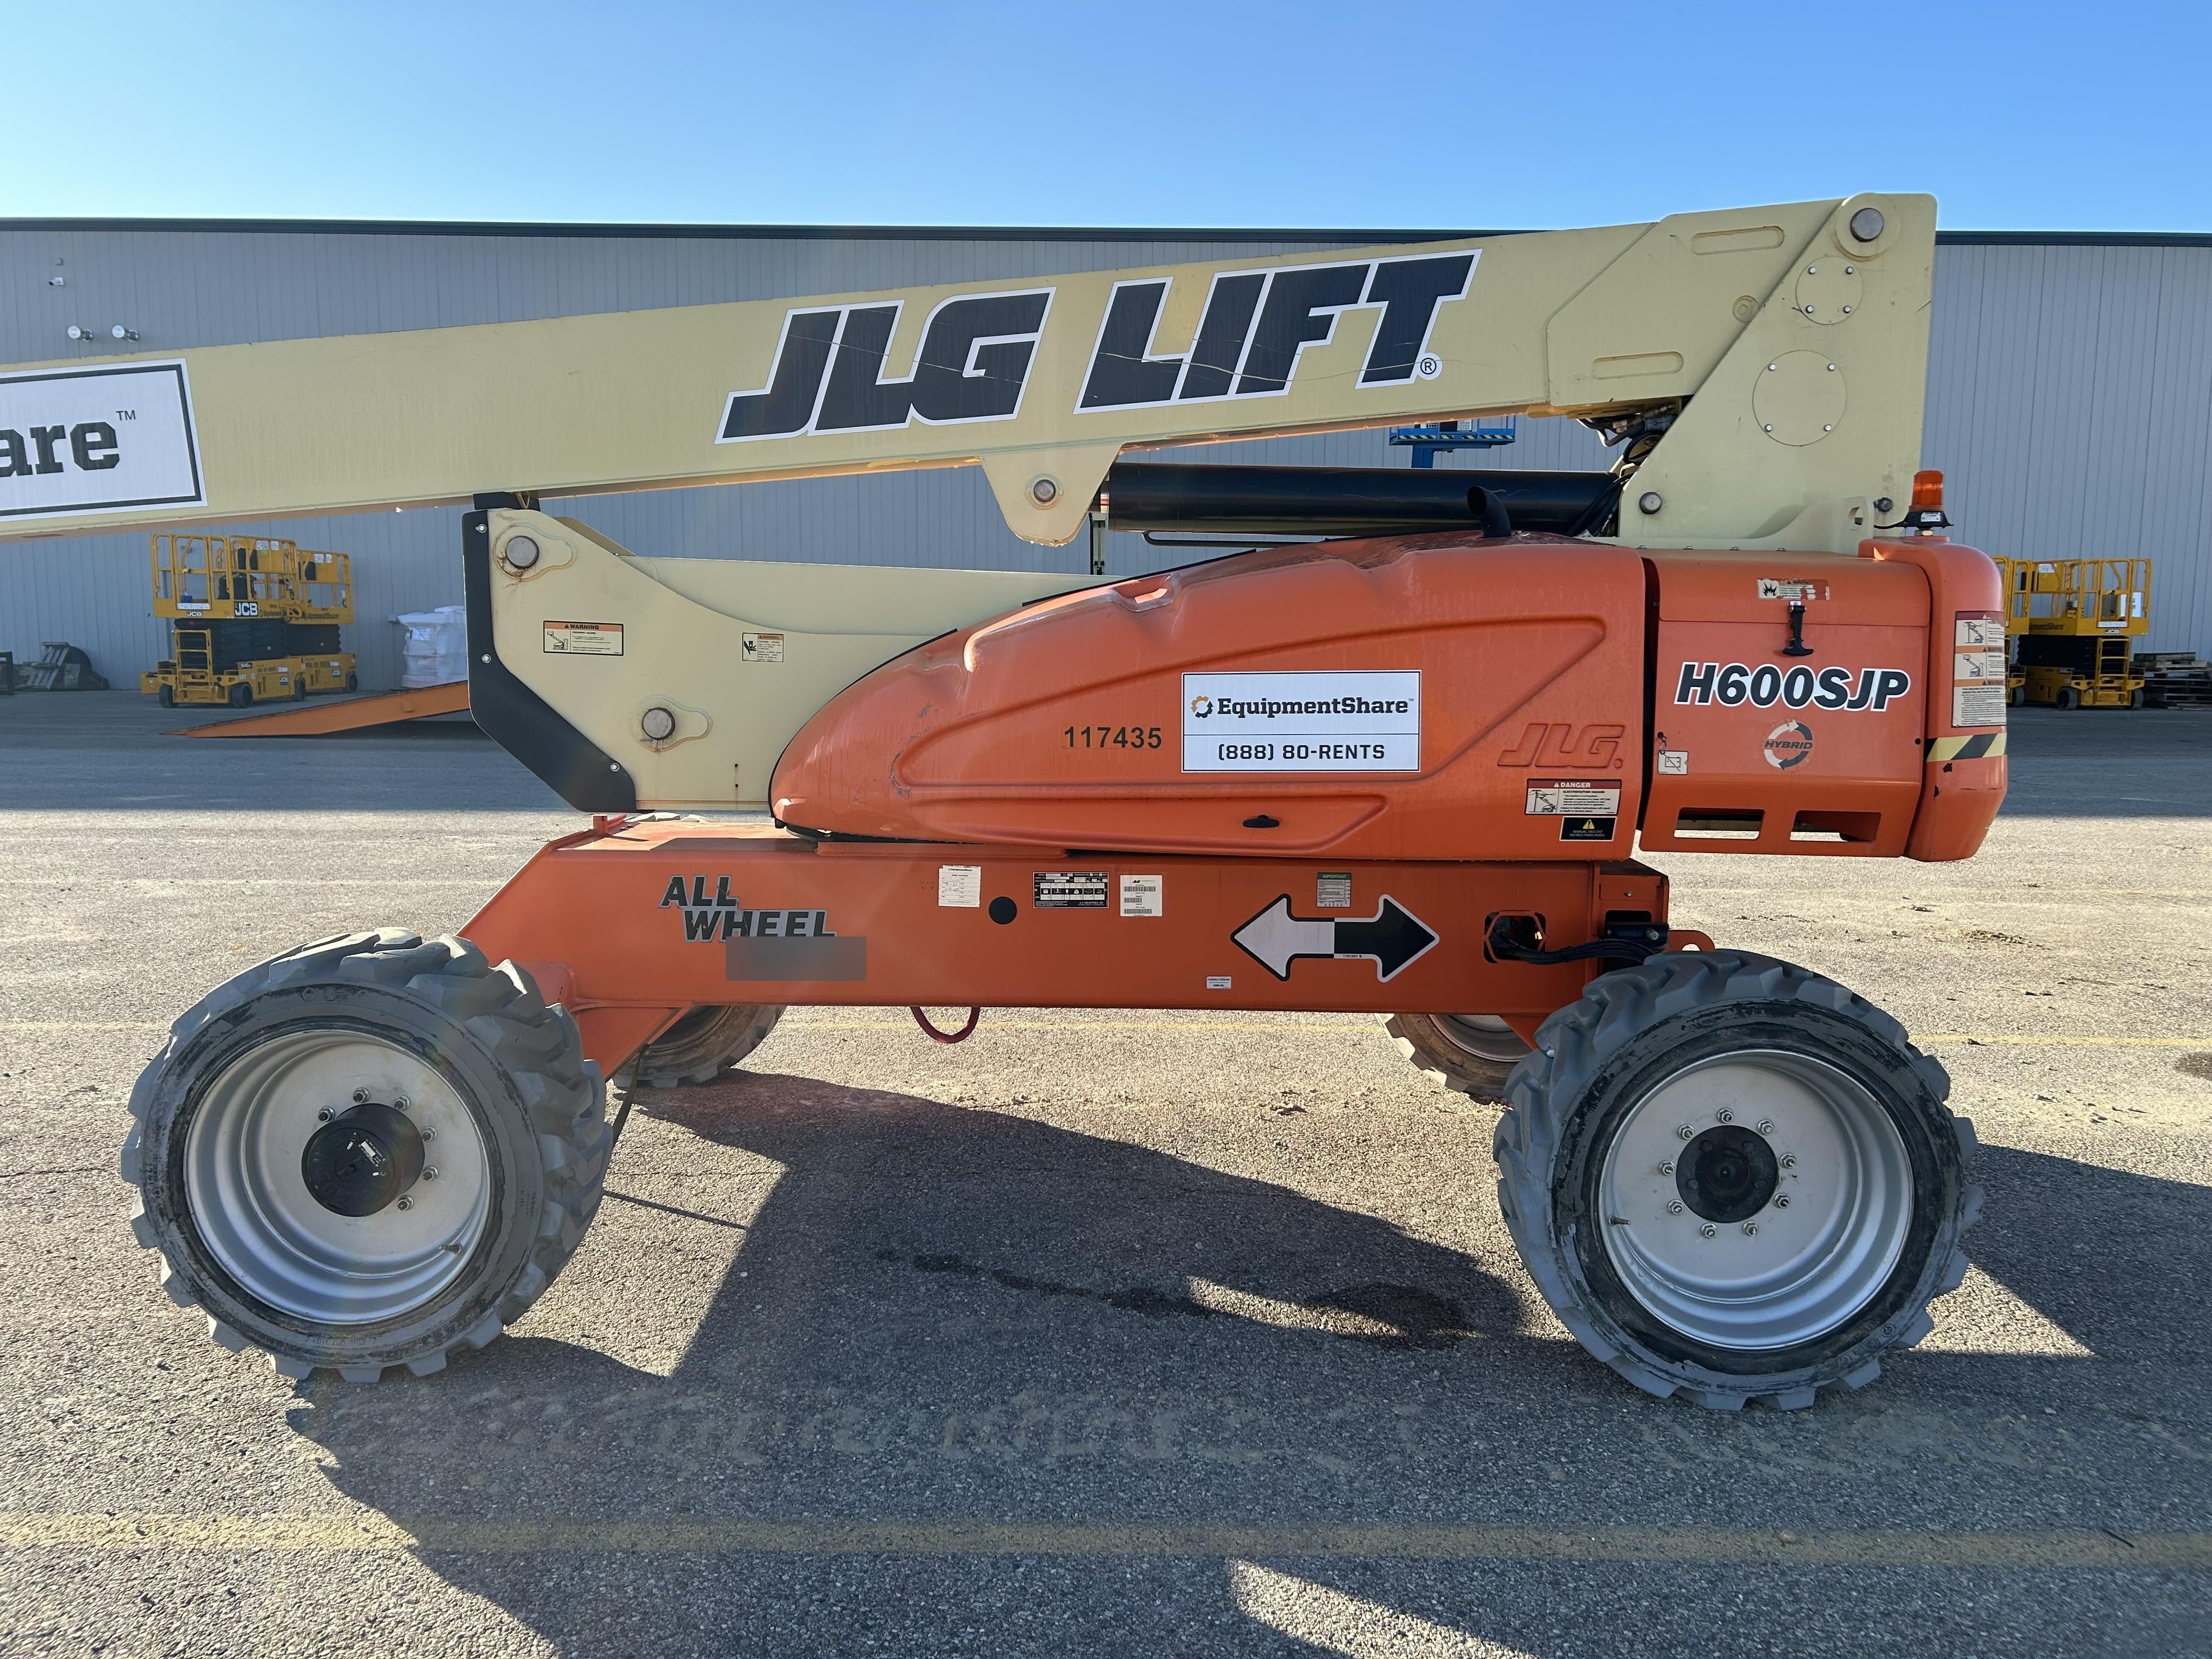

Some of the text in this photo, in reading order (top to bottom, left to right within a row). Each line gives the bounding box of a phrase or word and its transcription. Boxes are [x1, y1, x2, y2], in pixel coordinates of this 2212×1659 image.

[715, 287, 1056, 443] JLG
[235, 602, 258, 617] JCB
[1674, 662, 1909, 712] H600SJP
[1064, 727, 1162, 749] 117435
[1764, 741, 1813, 749] HYBRID
[1218, 743, 1385, 761] (888) 80-RENTS
[660, 875, 739, 907] ALL
[684, 910, 837, 941] WHEEL
